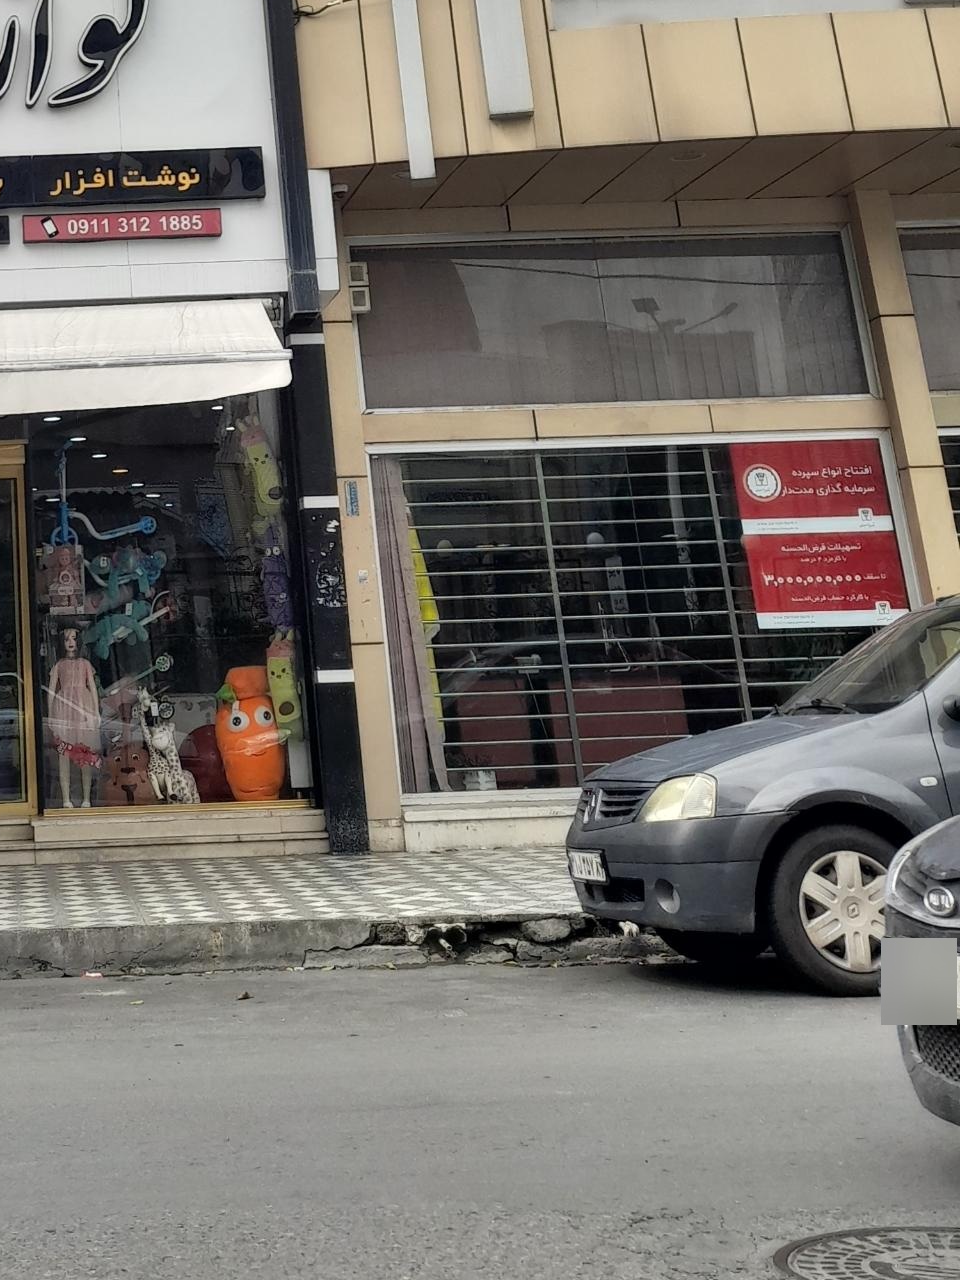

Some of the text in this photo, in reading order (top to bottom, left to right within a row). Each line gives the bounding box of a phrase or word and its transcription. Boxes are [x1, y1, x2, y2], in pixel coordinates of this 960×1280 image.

[49, 166, 200, 196] نوشت افزار
[66, 213, 204, 236] 0911 312 1885
[791, 466, 873, 480] افتتاح انواع سپرده
[843, 484, 876, 495] سرمایه
